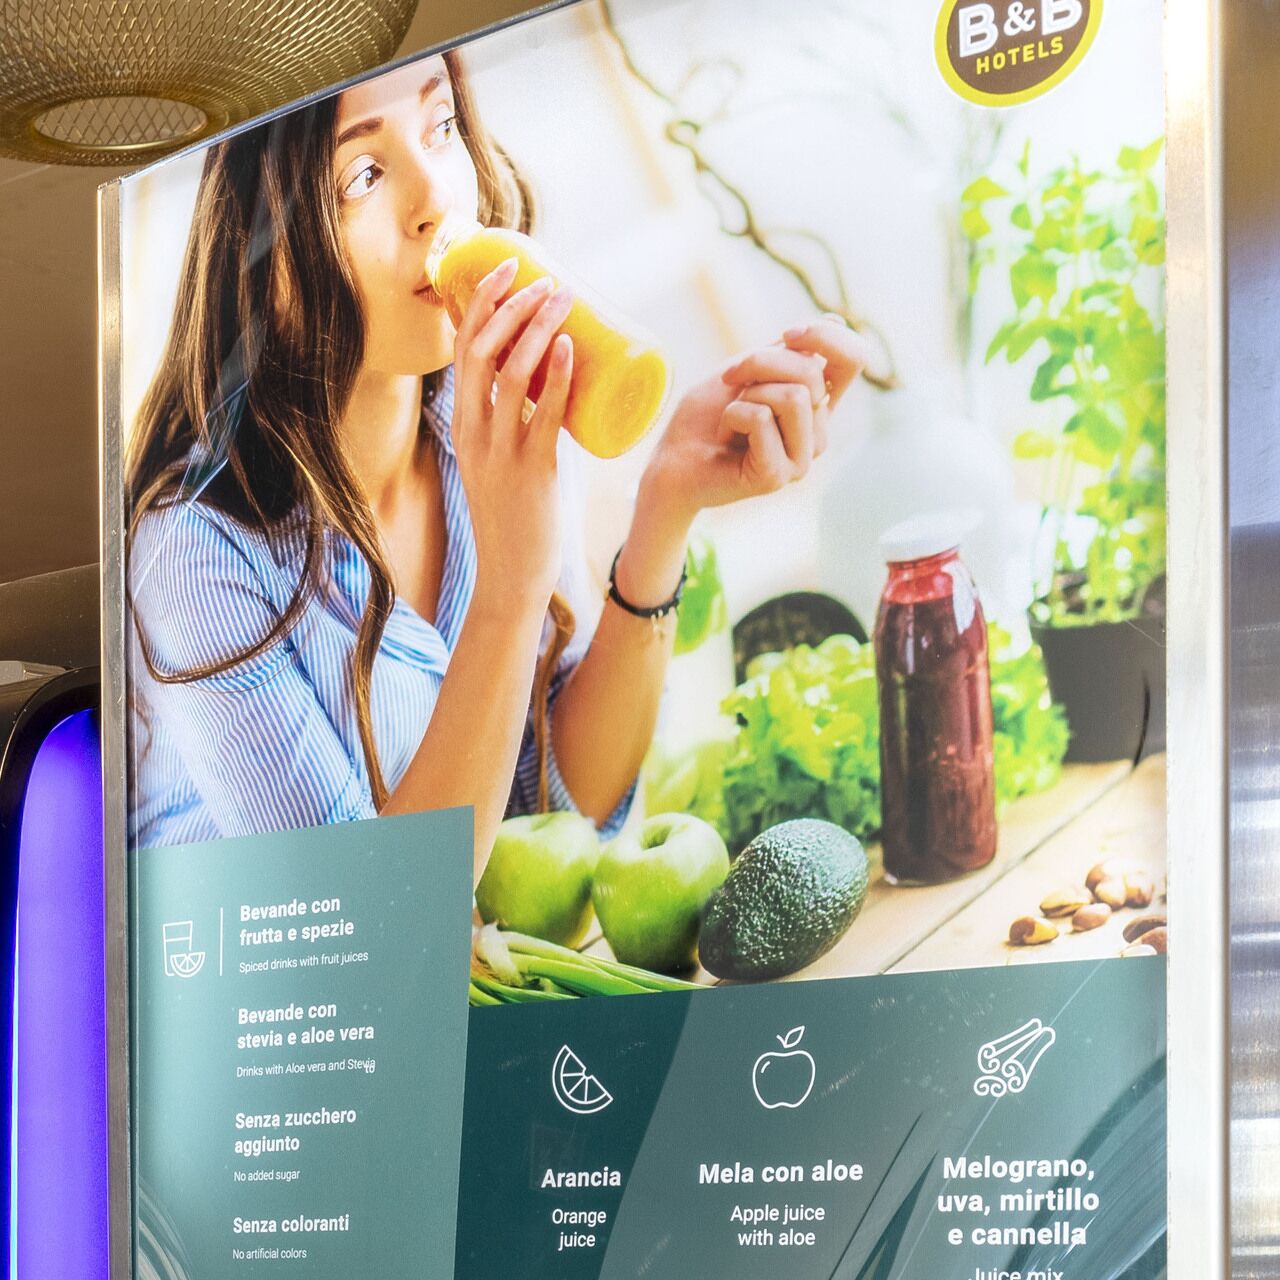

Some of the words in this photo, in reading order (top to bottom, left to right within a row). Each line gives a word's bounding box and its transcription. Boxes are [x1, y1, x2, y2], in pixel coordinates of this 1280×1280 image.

[958, 0, 1083, 58] B&B
[976, 36, 1064, 75] HOTELS
[240, 899, 307, 924] Bevande
[310, 896, 341, 916] con
[239, 926, 282, 947] frutta
[287, 926, 297, 941] e
[301, 919, 355, 942] spezie
[239, 960, 269, 974] Spiced
[270, 957, 298, 971] drinks
[300, 955, 319, 967] with
[321, 953, 339, 965] fruit
[340, 952, 368, 966] juices
[238, 1005, 304, 1026] Bevande
[308, 1001, 337, 1021] con
[237, 1029, 283, 1051] stevia
[287, 1031, 297, 1046] e
[301, 1025, 336, 1045] aloe
[340, 1024, 375, 1042] vera
[236, 1066, 263, 1078] Drinks
[265, 1064, 283, 1075] with
[285, 1063, 305, 1074] Aloe
[307, 1063, 326, 1072] vera
[329, 1059, 345, 1071] and
[347, 1058, 376, 1070] Stevia
[235, 1111, 280, 1131] Senza
[284, 1106, 357, 1128] zucchero
[234, 1134, 300, 1158] aggiunto
[234, 1170, 247, 1182] No
[250, 1170, 274, 1181] added
[276, 1169, 300, 1183] sugar
[541, 1166, 621, 1189] Arancia
[698, 1163, 755, 1185] Mela
[761, 1165, 805, 1183] con
[811, 1161, 864, 1182] aloe
[942, 1156, 1096, 1183] Melograno,
[937, 1194, 991, 1216] uva,
[999, 1189, 1100, 1212] mirtillo
[233, 1216, 277, 1234] Senza
[281, 1214, 350, 1233] coloranti
[551, 1208, 607, 1228] Orange
[730, 1206, 779, 1226] Apple
[783, 1205, 825, 1226] juice
[559, 1230, 596, 1251] juice
[737, 1229, 774, 1246] with
[778, 1228, 816, 1246] aloe
[947, 1228, 963, 1247] e
[970, 1222, 1087, 1246] cannella
[232, 1249, 245, 1260] No
[247, 1247, 278, 1260] artificial
[279, 1247, 307, 1259] colors
